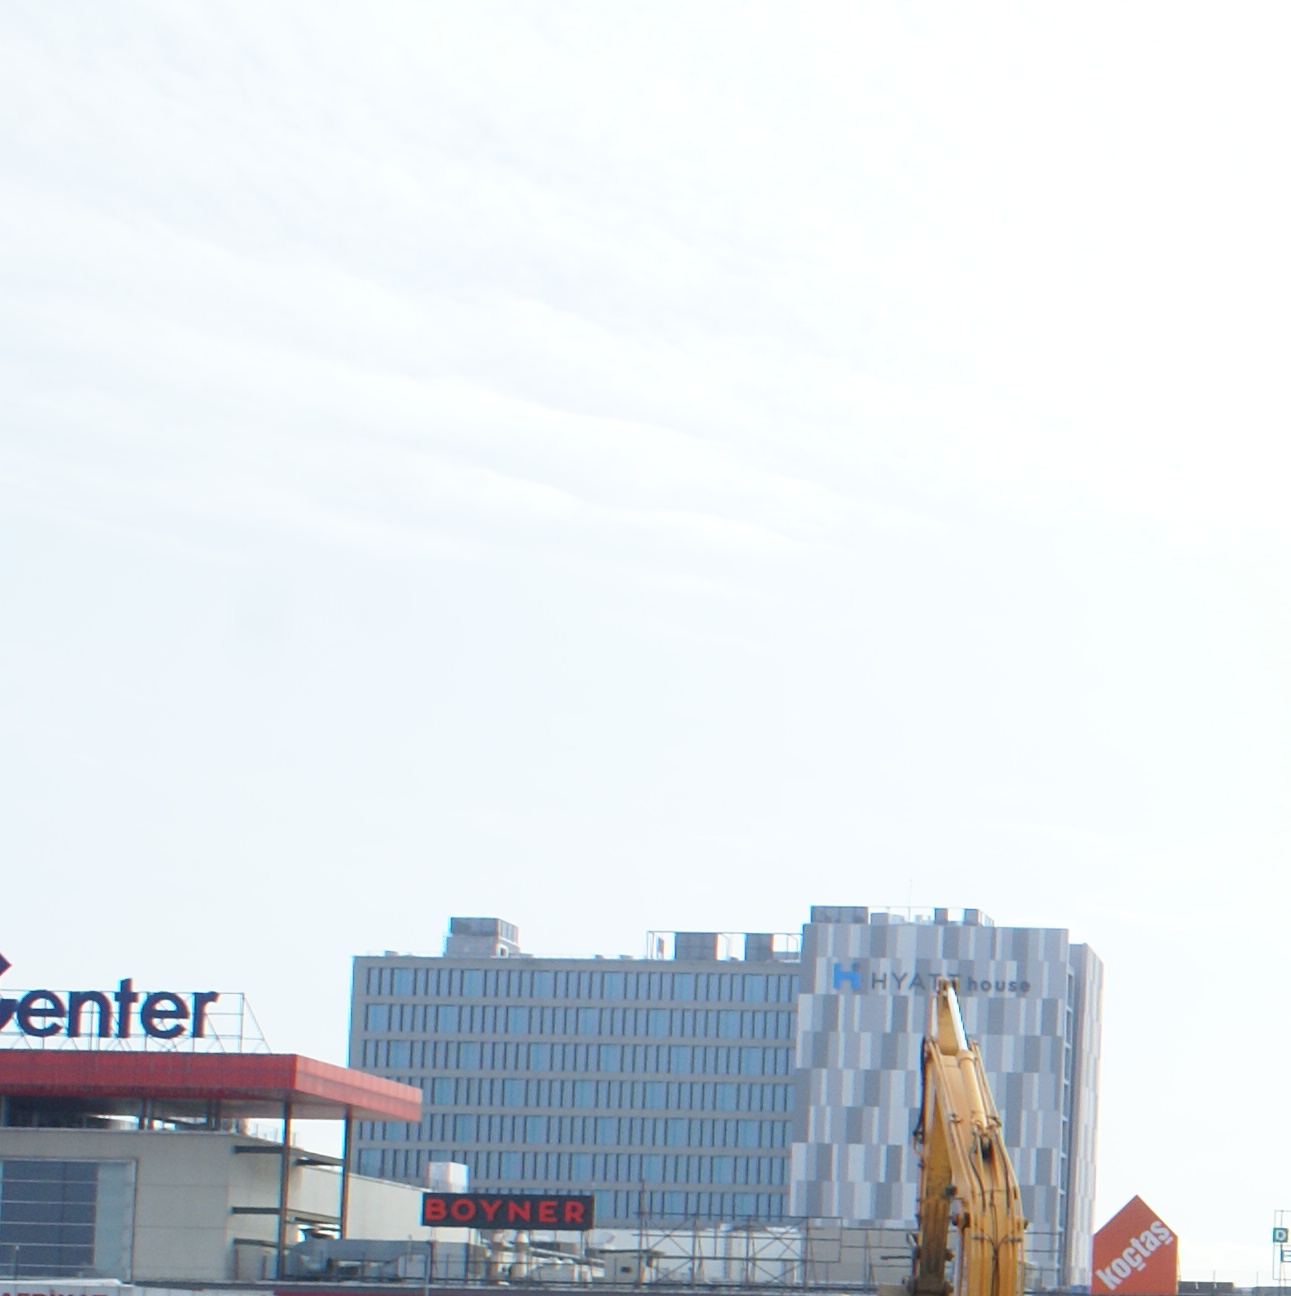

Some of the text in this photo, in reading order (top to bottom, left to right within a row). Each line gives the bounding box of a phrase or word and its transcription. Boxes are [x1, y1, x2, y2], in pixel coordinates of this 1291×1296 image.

[967, 975, 1031, 992] house
[424, 1198, 585, 1223] BOYNER
[1096, 1220, 1174, 1290] koçtaş
